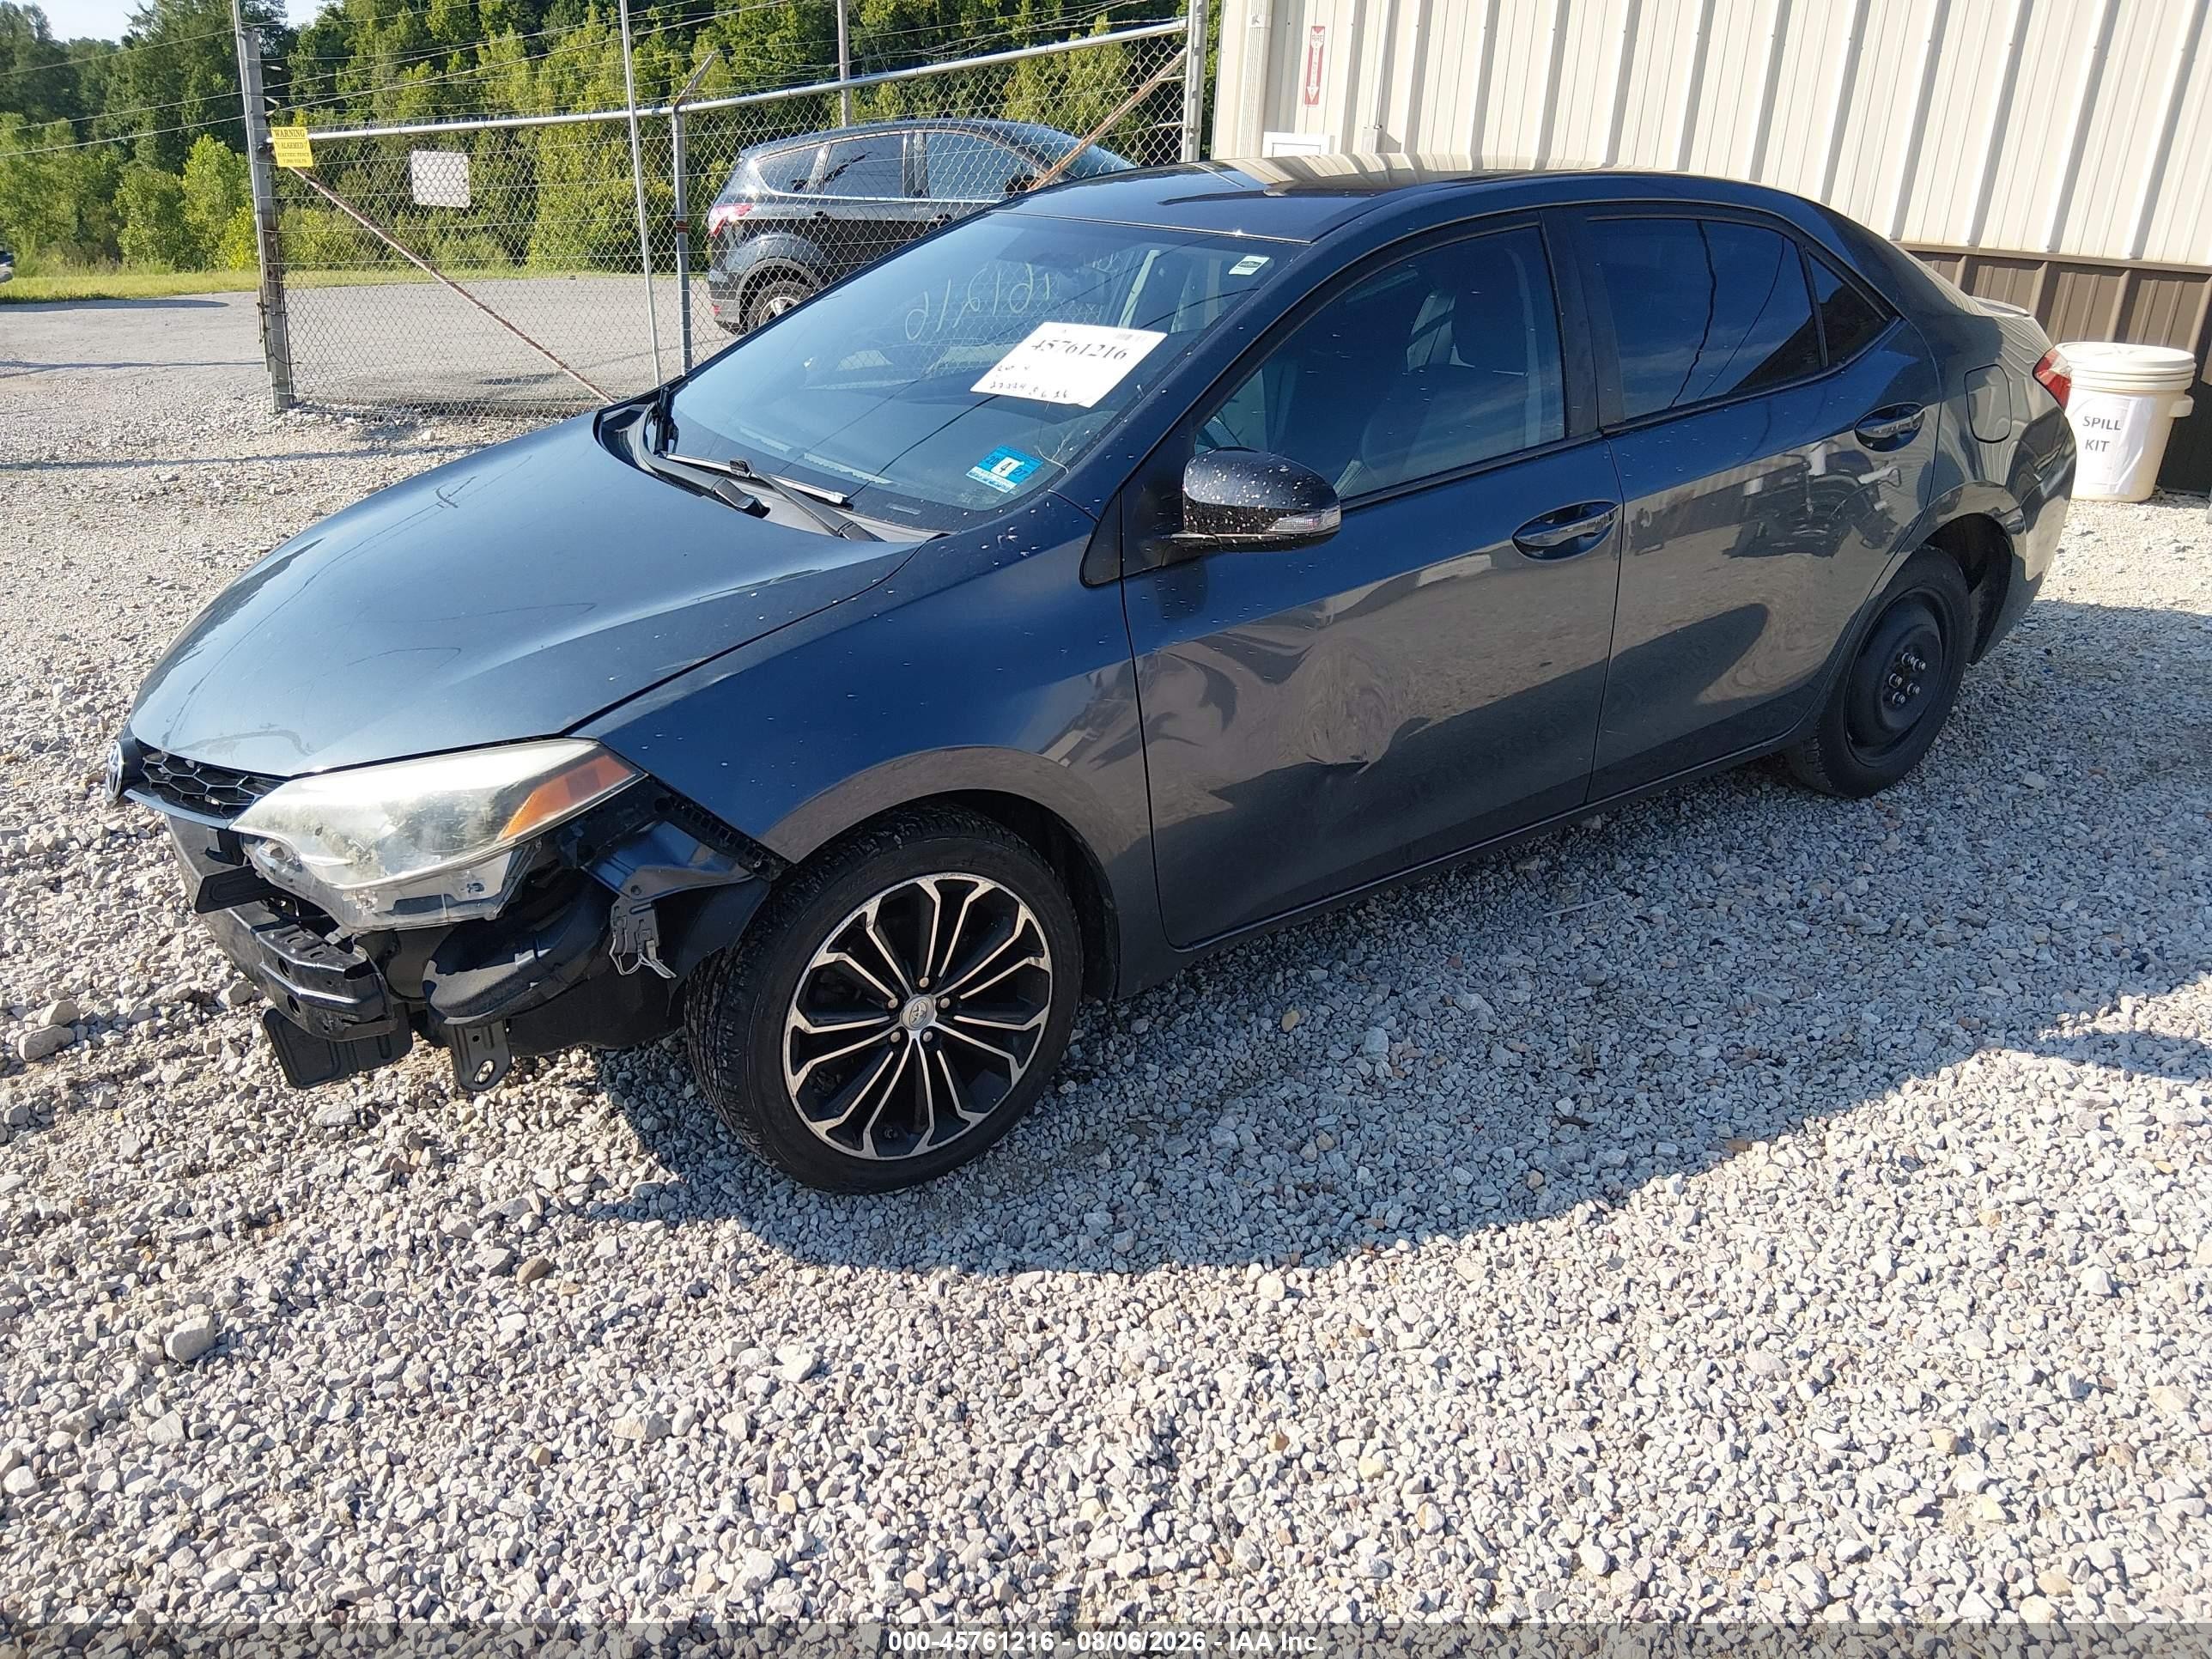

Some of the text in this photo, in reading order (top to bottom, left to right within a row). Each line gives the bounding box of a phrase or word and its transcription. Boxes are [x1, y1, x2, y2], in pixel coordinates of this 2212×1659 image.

[273, 129, 305, 137] WARNING
[1031, 339, 1127, 361] 45761216
[2082, 416, 2121, 430] SPILL
[2085, 439, 2110, 452] KIT
[1000, 461, 1012, 473] 4
